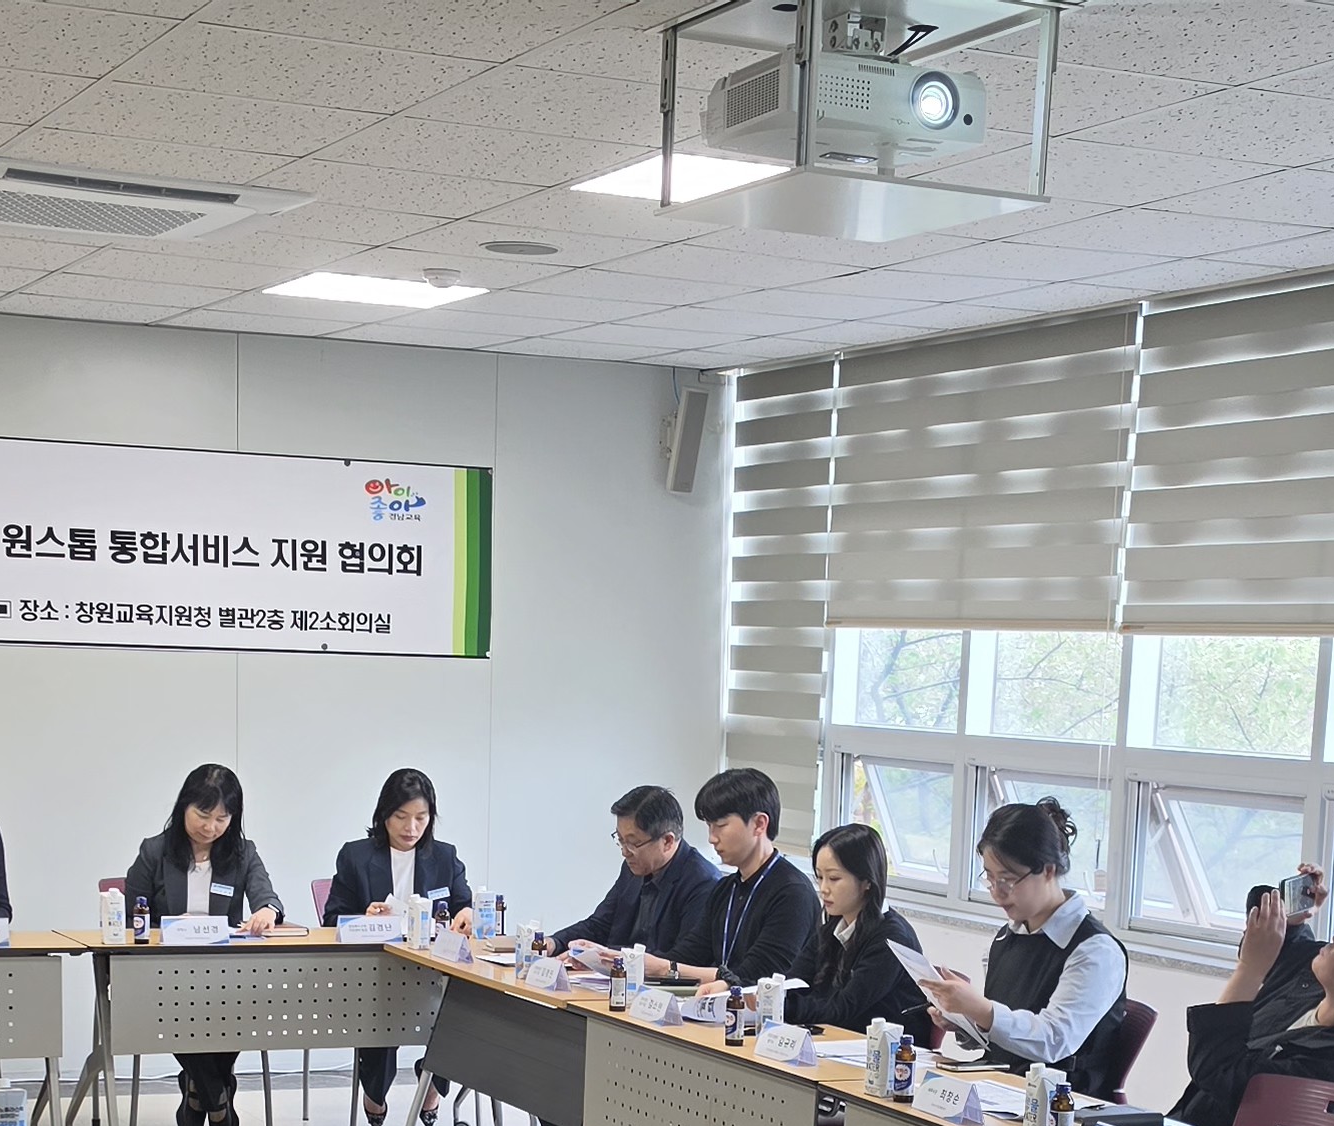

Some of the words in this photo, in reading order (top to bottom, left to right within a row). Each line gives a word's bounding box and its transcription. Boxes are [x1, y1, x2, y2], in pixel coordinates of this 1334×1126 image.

[365, 478, 411, 497] 아이
[369, 496, 426, 521] 좋아
[2, 523, 97, 562] 원스톱
[108, 529, 260, 568] 통합서비스
[270, 538, 328, 572] 지원
[337, 541, 423, 577] 협의회
[19, 599, 59, 622] 장소
[75, 601, 212, 628] 창원교육지원청
[218, 606, 285, 631] 별관2층
[290, 610, 392, 634] 제2소회의실
